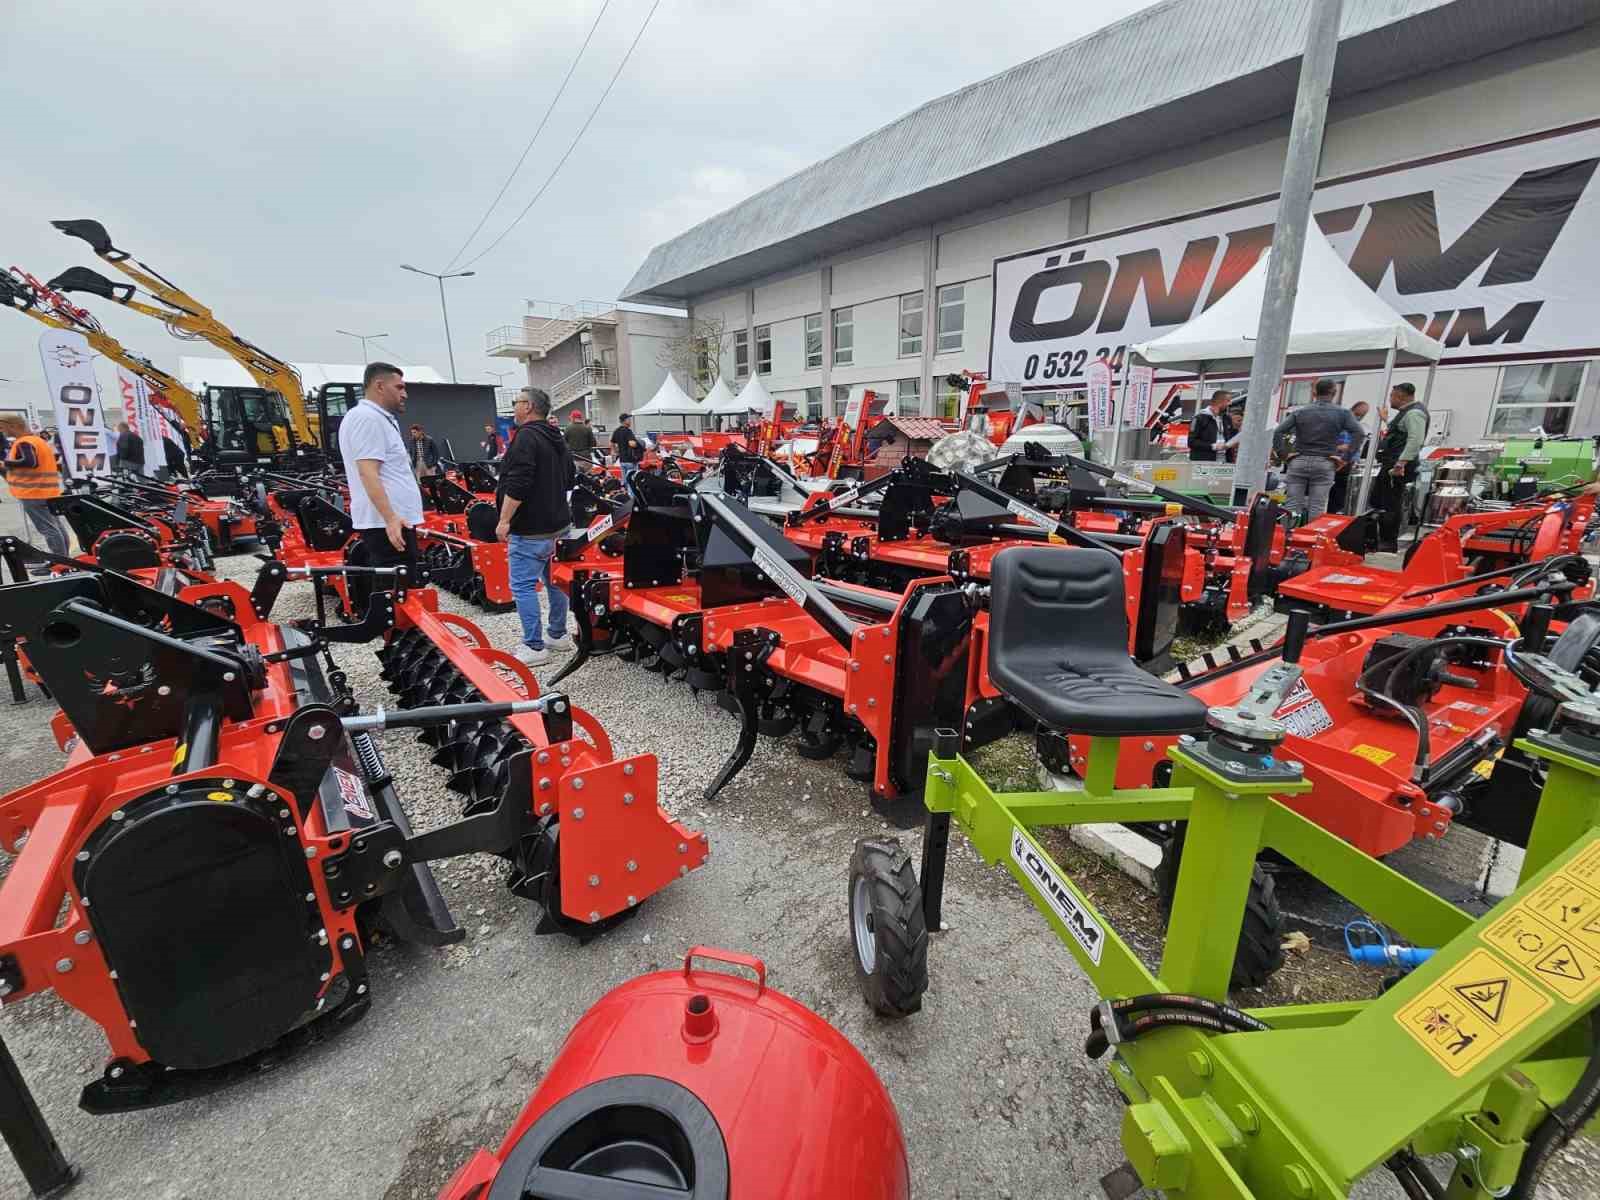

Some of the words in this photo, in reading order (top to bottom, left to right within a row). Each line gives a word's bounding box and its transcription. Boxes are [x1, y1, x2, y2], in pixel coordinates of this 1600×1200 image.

[1024, 354, 1040, 381] 0
[1043, 348, 1089, 380] 532
[1025, 851, 1100, 945] ÖNEM
